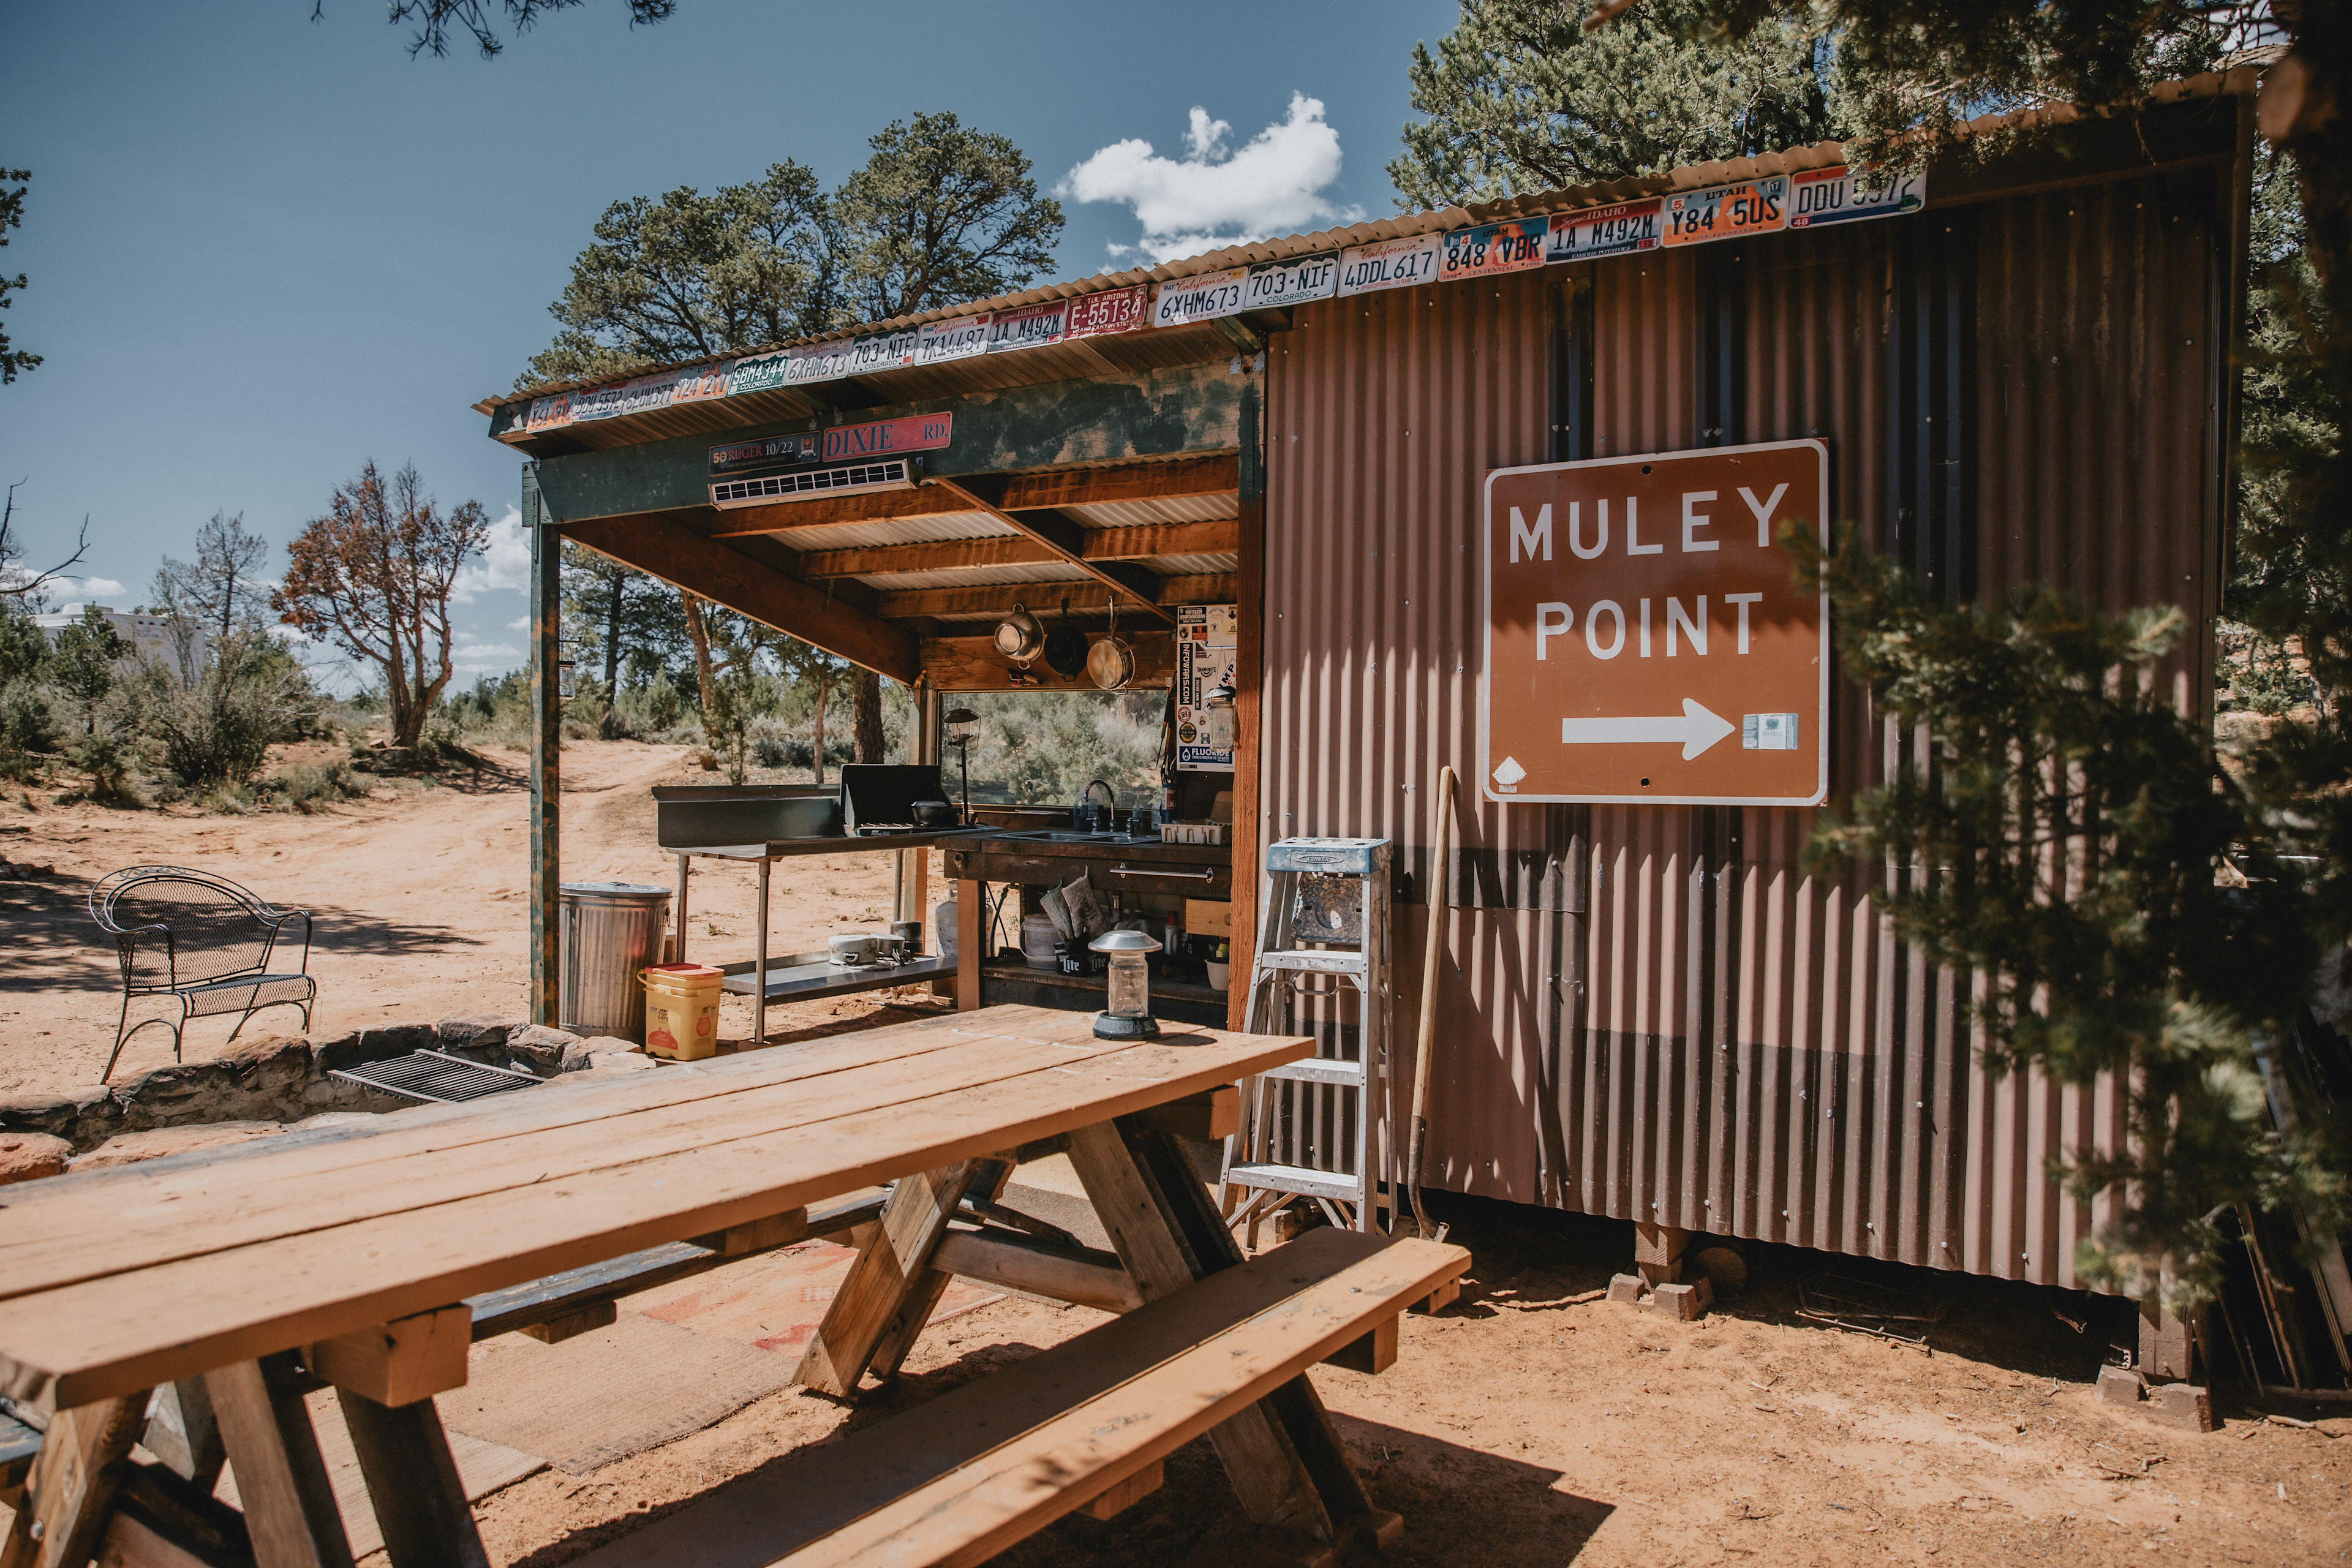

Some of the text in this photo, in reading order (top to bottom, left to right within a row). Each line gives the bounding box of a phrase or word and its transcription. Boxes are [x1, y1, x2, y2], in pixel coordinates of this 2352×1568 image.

[1705, 186, 1746, 201] UTAH
[1798, 181, 1844, 214] DDU
[1672, 194, 1780, 235] Y84 5US
[1674, 200, 1682, 209] 5
[1561, 206, 1627, 228] Scenic IDAHO
[1461, 236, 1469, 245] 4
[1483, 227, 1508, 238] UTAH
[1553, 214, 1654, 251] 1A M492M
[1362, 243, 1422, 260] California
[1447, 233, 1541, 271] 848 VBR
[1572, 246, 1630, 259] FAMOUS POTATOES
[1344, 251, 1433, 287] 4DDL617
[1468, 265, 1514, 276] CENTENNIAL
[1177, 277, 1231, 292] California
[1102, 292, 1129, 301] ARIZONA
[1161, 285, 1239, 319] 6XHM673
[1266, 290, 1312, 304] COLORADO
[1017, 306, 1044, 317] IDAHO
[1070, 296, 1142, 330] E-55134
[934, 320, 978, 334] California
[993, 313, 1060, 342] 1A M492M
[1091, 323, 1115, 331] CANYON
[803, 344, 841, 357] California
[922, 328, 985, 359] 7K14487
[732, 358, 787, 385] SBM4344
[788, 353, 847, 380] 6XHM673
[865, 360, 897, 370] COLORADO
[677, 378, 699, 398] Y24
[740, 379, 772, 390] COLORADO
[597, 390, 623, 411] 5572
[825, 423, 949, 458] DIXIE RD.
[713, 451, 728, 464] 50
[729, 446, 763, 461] RUGER
[766, 441, 793, 456] 10/22
[1509, 483, 1790, 564] MULEY
[1536, 592, 1763, 661] POINT
[1182, 644, 1191, 704] INFOWARS.COM
[1063, 958, 1080, 973] Lite
[1091, 957, 1106, 972] Lite
